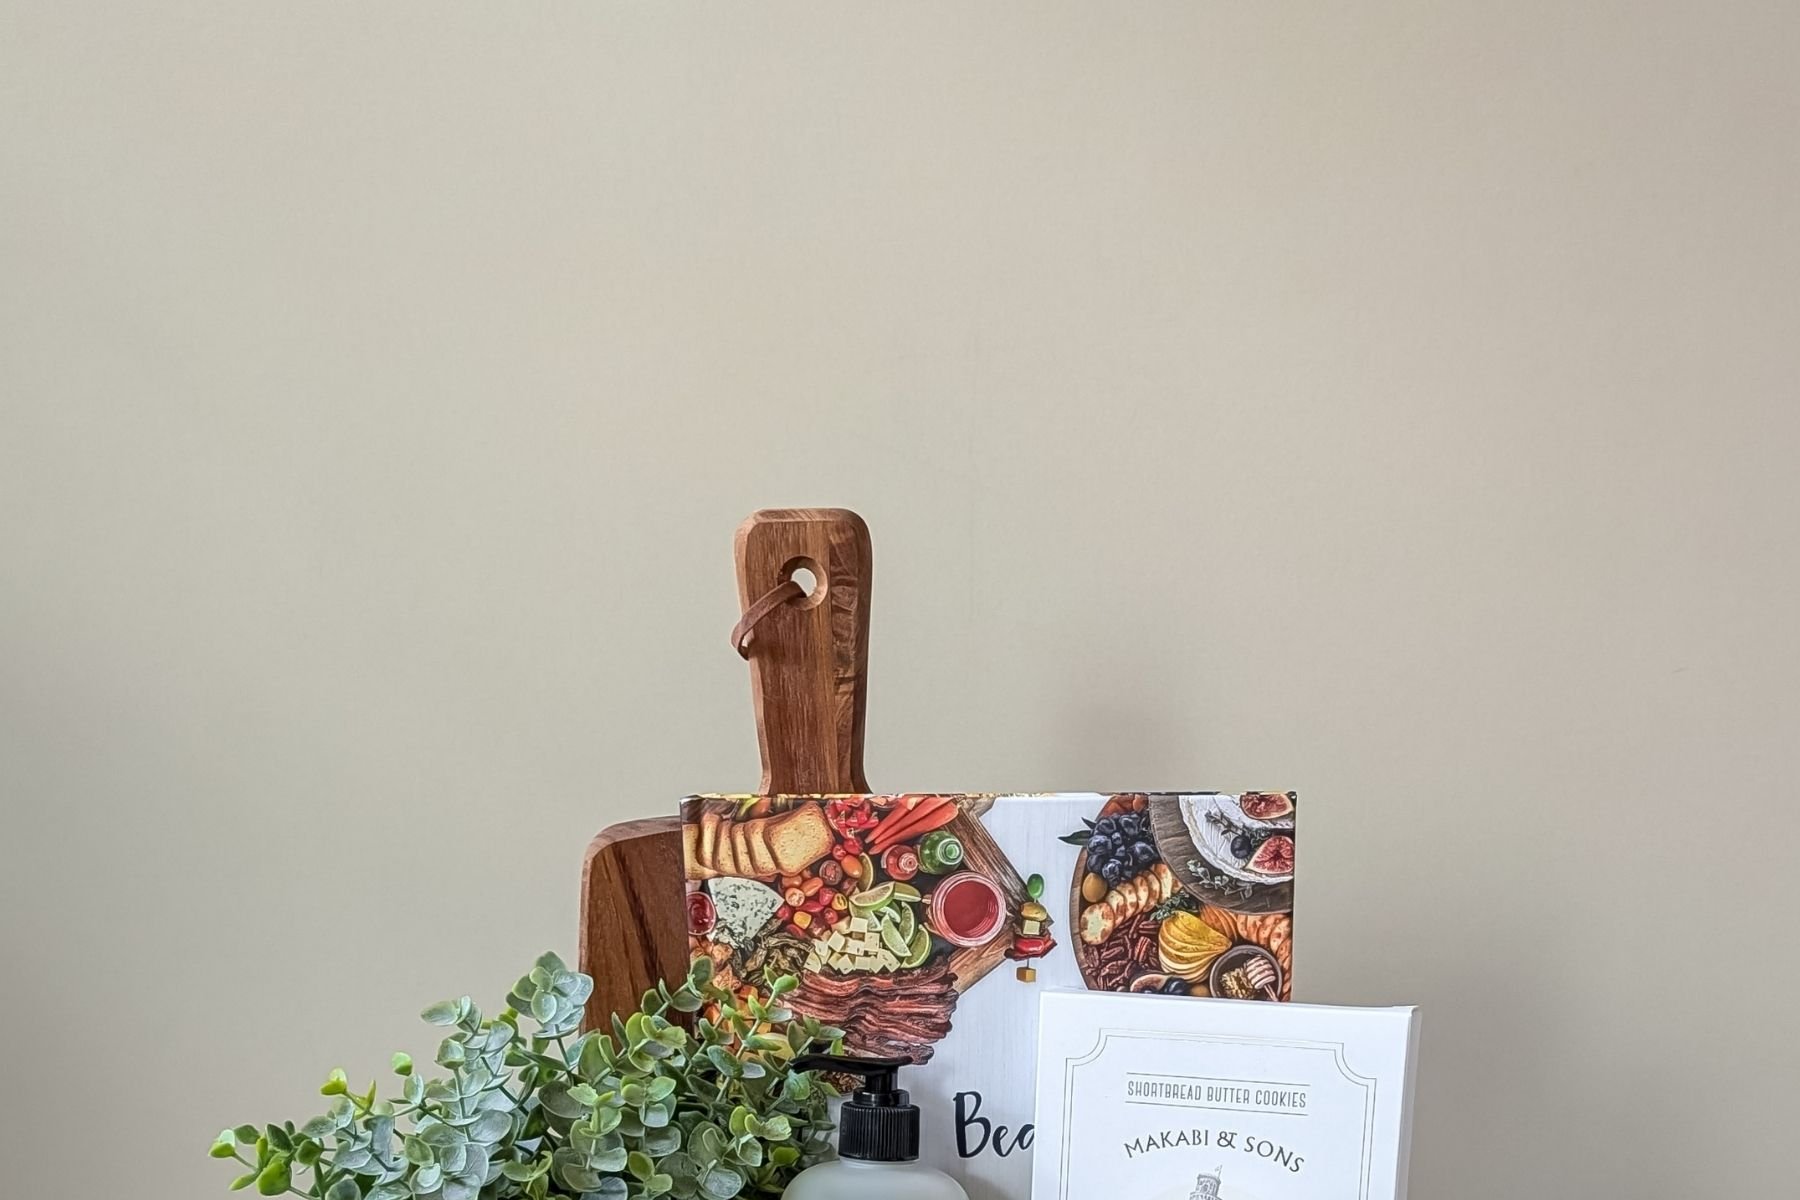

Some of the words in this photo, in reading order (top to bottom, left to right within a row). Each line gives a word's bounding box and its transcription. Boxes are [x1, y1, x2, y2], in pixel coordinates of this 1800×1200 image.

[1127, 1080, 1202, 1101] SHORTBREAD
[1206, 1086, 1250, 1104] BUTTER
[1255, 1089, 1306, 1108] COOKIES
[1123, 1129, 1209, 1159] MAKABI
[1216, 1130, 1238, 1149] &
[1243, 1136, 1305, 1173] SONS
